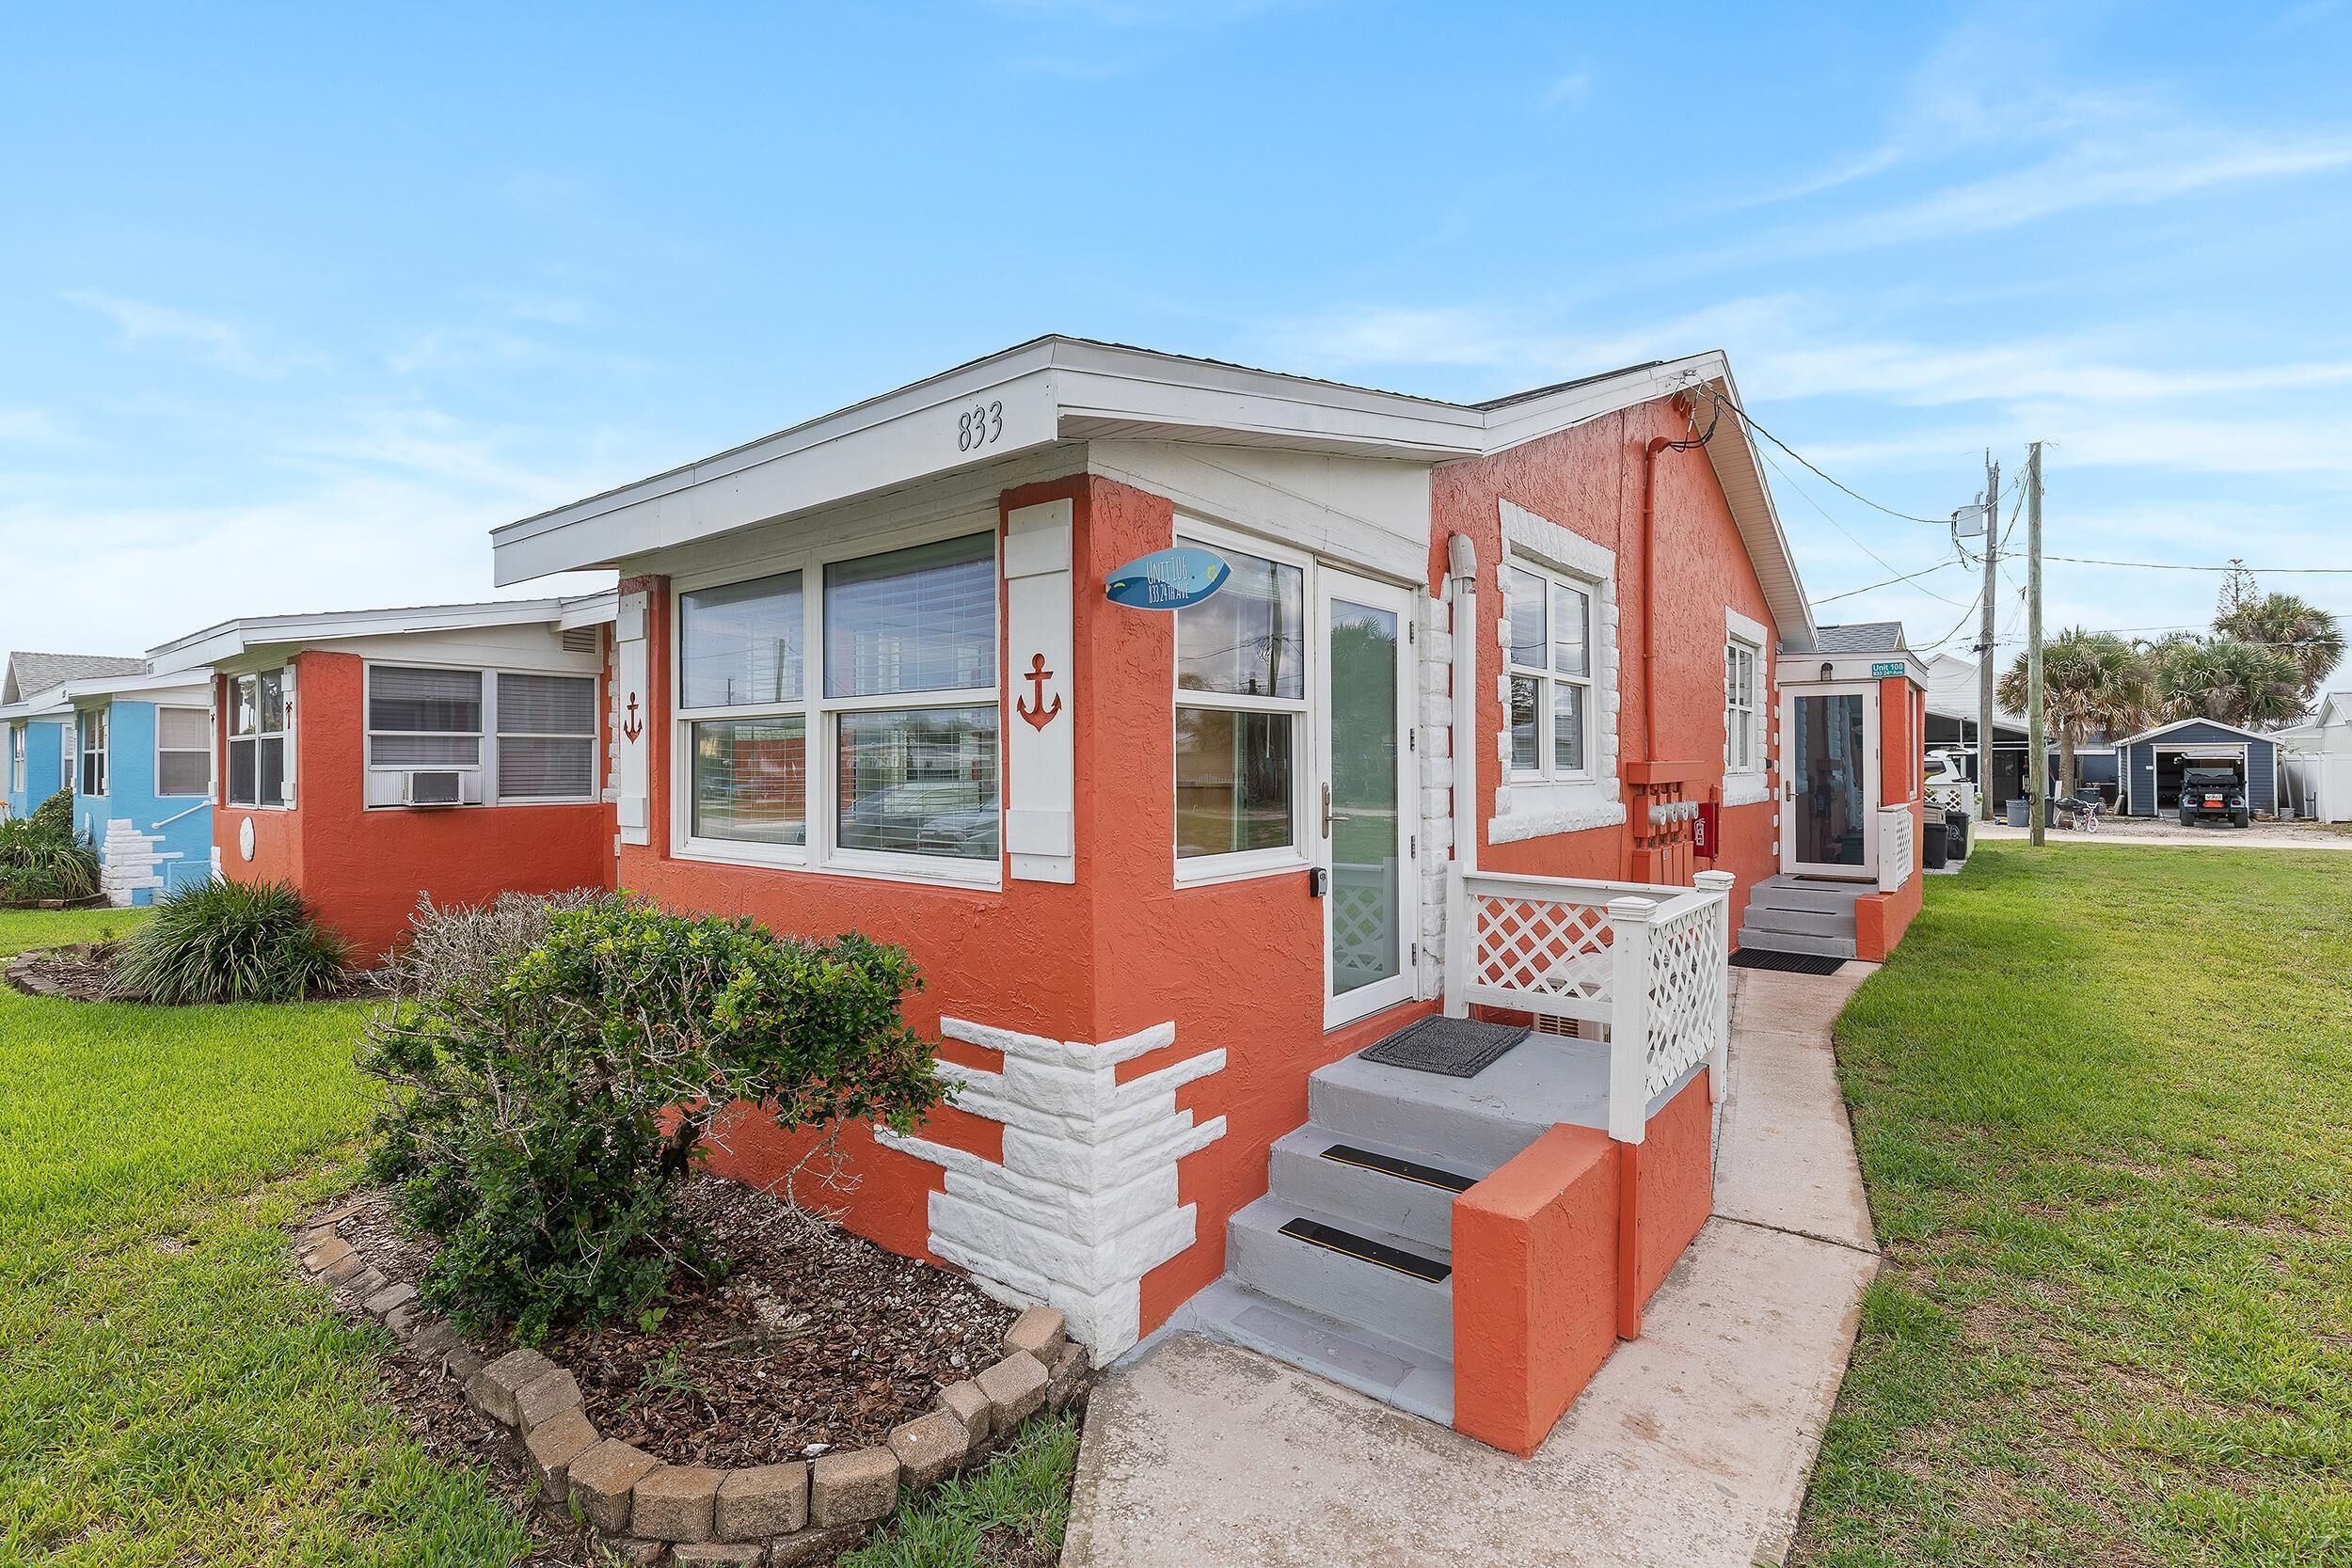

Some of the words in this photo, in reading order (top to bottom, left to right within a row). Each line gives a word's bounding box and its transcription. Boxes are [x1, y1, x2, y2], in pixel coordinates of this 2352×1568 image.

[958, 401, 1003, 451] 833
[1147, 562, 1170, 584] UNIT
[1171, 555, 1188, 581] 106
[1149, 584, 1160, 604] 833
[1160, 583, 1175, 602] 24TH
[1176, 582, 1189, 599] AVE
